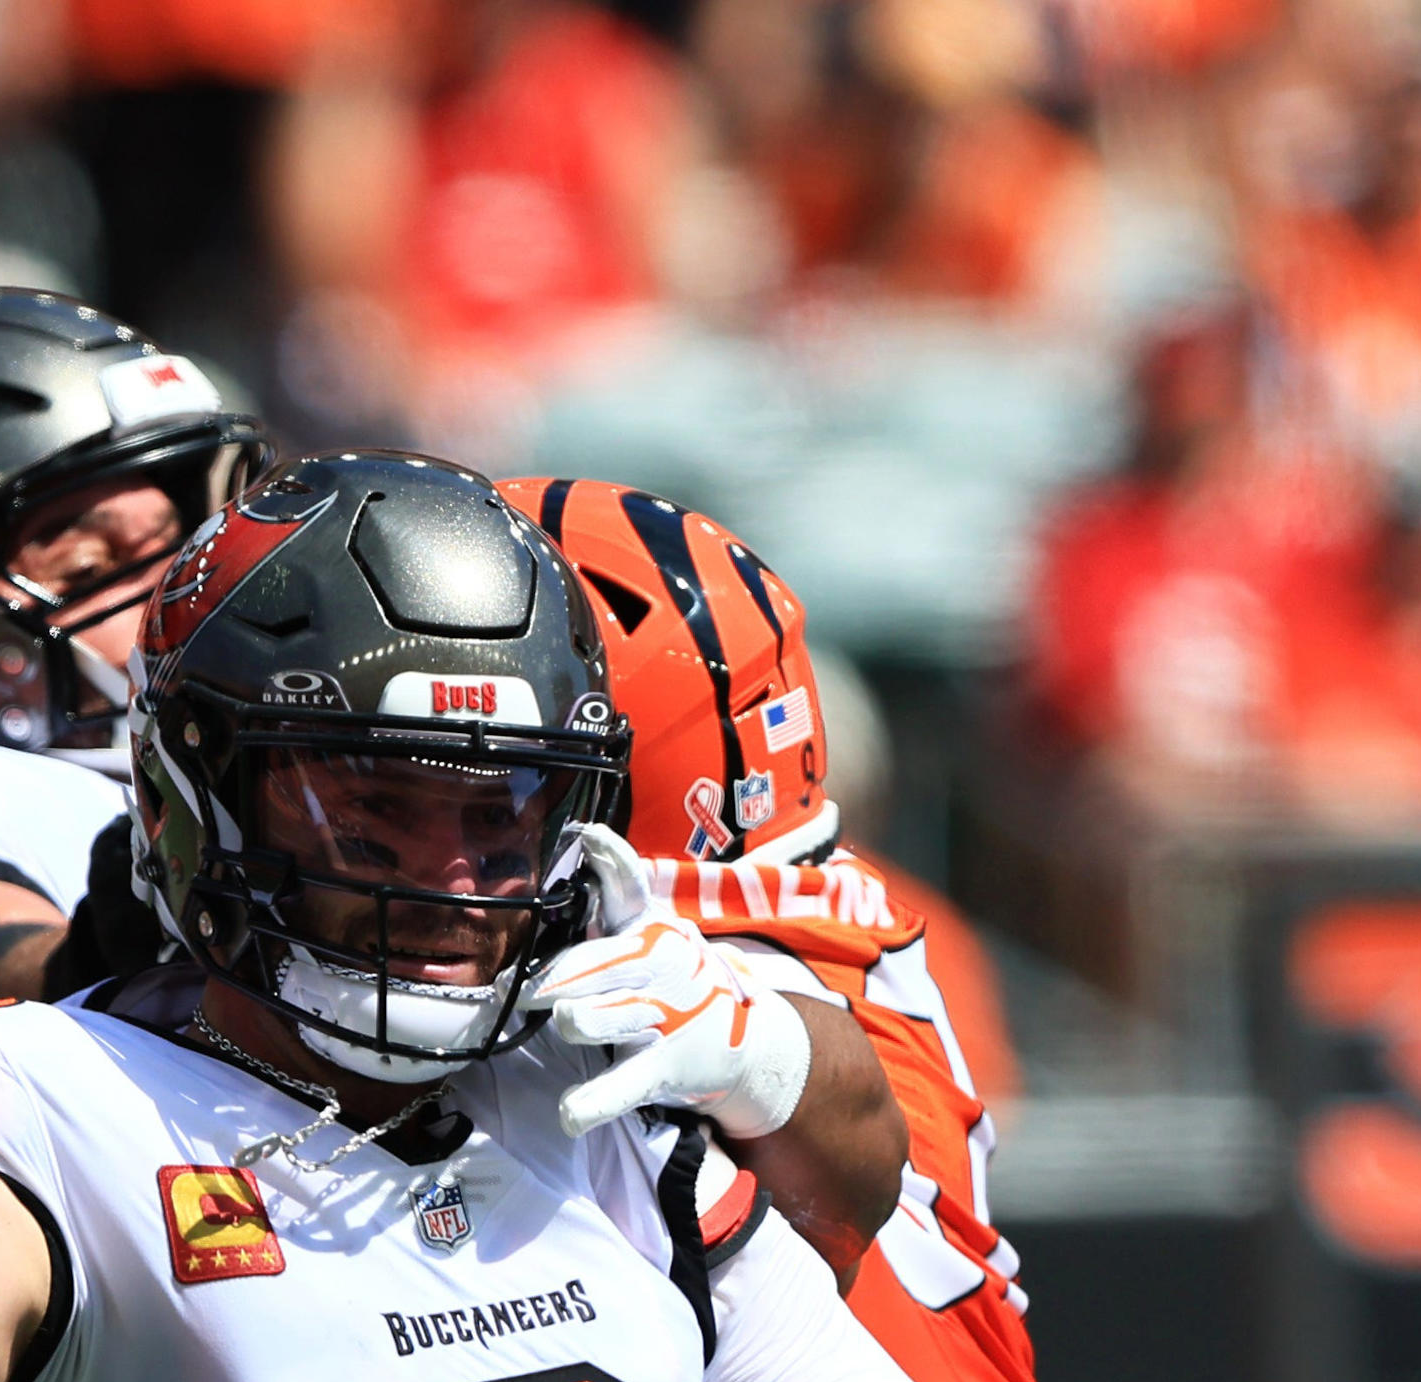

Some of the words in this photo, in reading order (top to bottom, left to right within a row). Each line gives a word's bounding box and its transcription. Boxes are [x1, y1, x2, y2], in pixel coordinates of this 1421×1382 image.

[262, 692, 335, 705] OAKLEY
[431, 681, 497, 714] BUCS
[424, 1206, 467, 1239] NFL
[380, 1279, 596, 1357] BUCCANEERS
